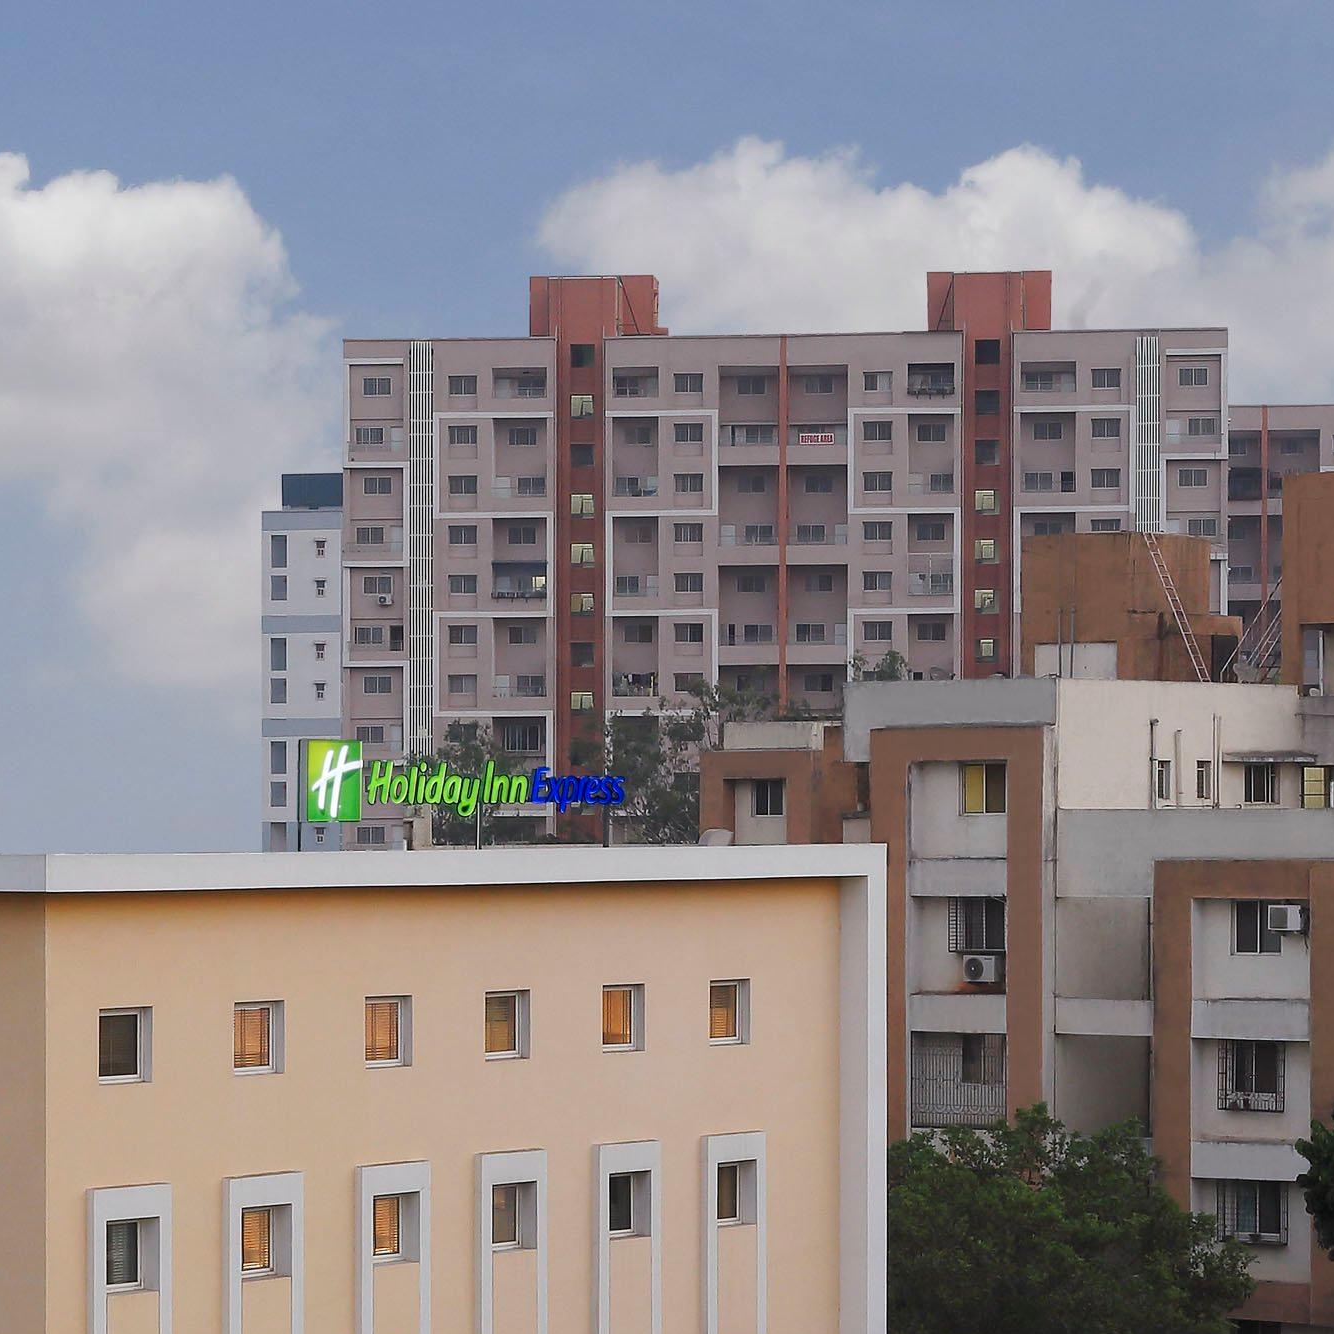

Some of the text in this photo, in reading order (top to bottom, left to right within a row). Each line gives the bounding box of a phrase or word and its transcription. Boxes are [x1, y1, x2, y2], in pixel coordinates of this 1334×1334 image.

[820, 435, 833, 443] AREA
[367, 759, 626, 817] Holiday Inn Express
